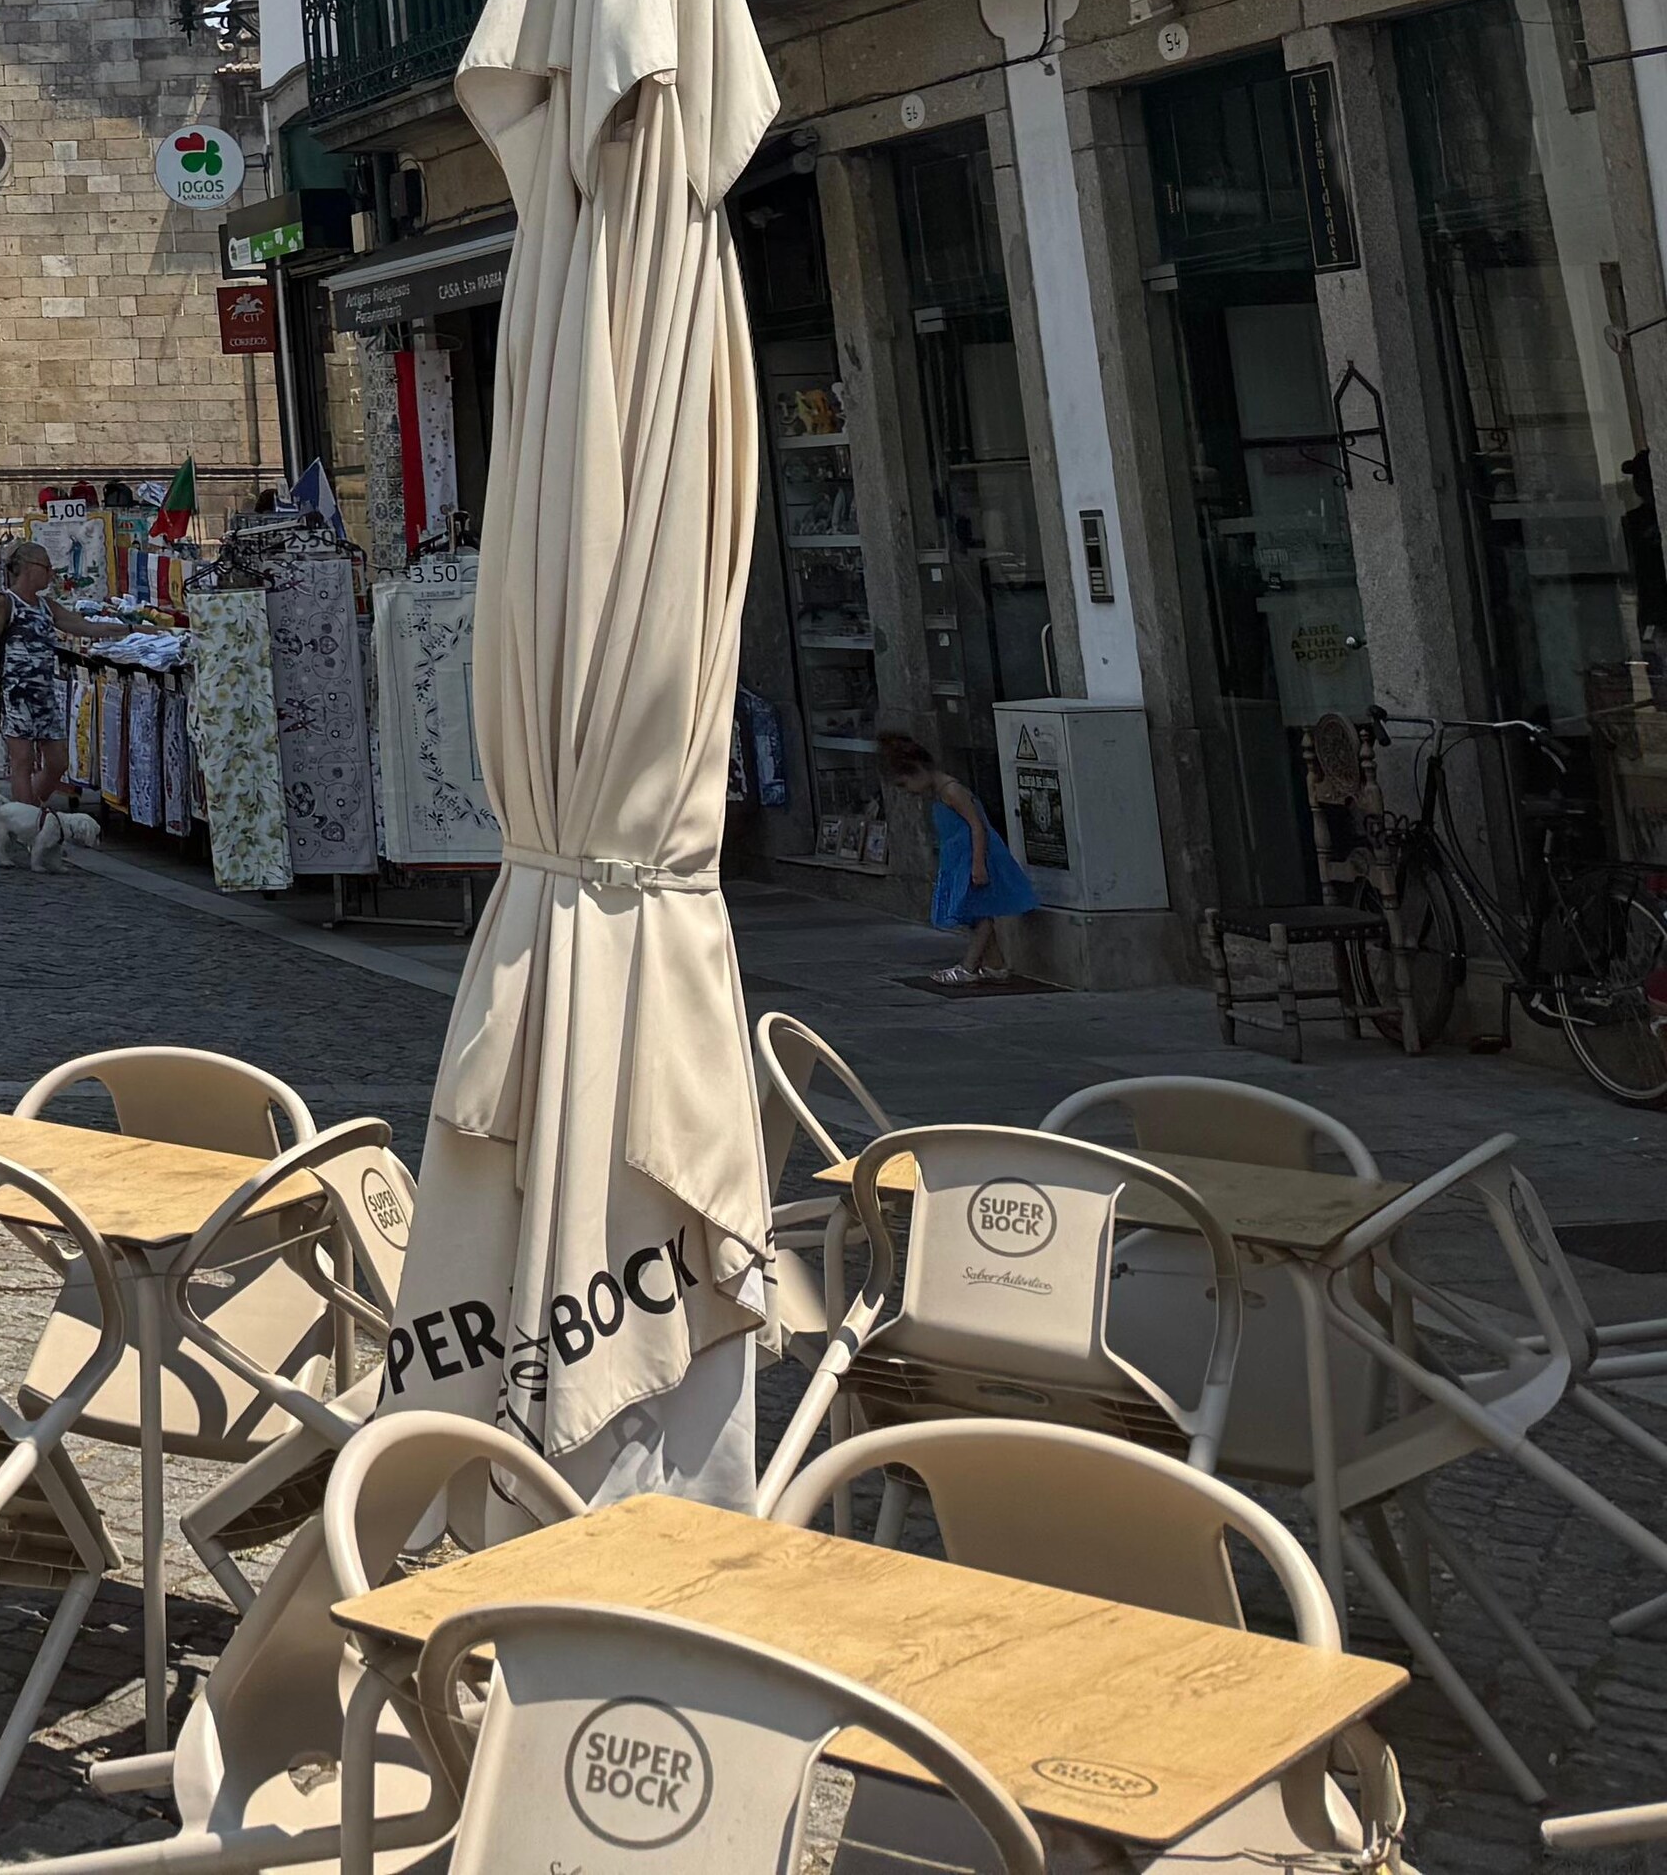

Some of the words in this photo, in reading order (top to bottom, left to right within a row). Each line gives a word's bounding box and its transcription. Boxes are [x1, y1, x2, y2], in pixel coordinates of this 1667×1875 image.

[1165, 31, 1181, 52] 54
[1307, 77, 1339, 262] Antiguidades
[177, 179, 225, 198] JOGOS
[372, 283, 411, 303] Religiosos
[438, 284, 462, 300] CASA
[477, 270, 504, 292] MARIA
[243, 313, 261, 323] CTT
[49, 502, 86, 520] 1,00
[286, 529, 334, 552] 2,50
[411, 564, 458, 584] 3.50
[1297, 624, 1343, 638] ABRE
[1305, 636, 1336, 649] TUA
[1294, 648, 1349, 662] PORTA
[979, 1197, 1044, 1221] SUPER
[981, 1214, 1040, 1237] BOCK
[381, 1299, 505, 1401] PER
[549, 1224, 699, 1367] BOCK
[585, 1731, 693, 1784] SUPER
[585, 1762, 683, 1814] BOCK
